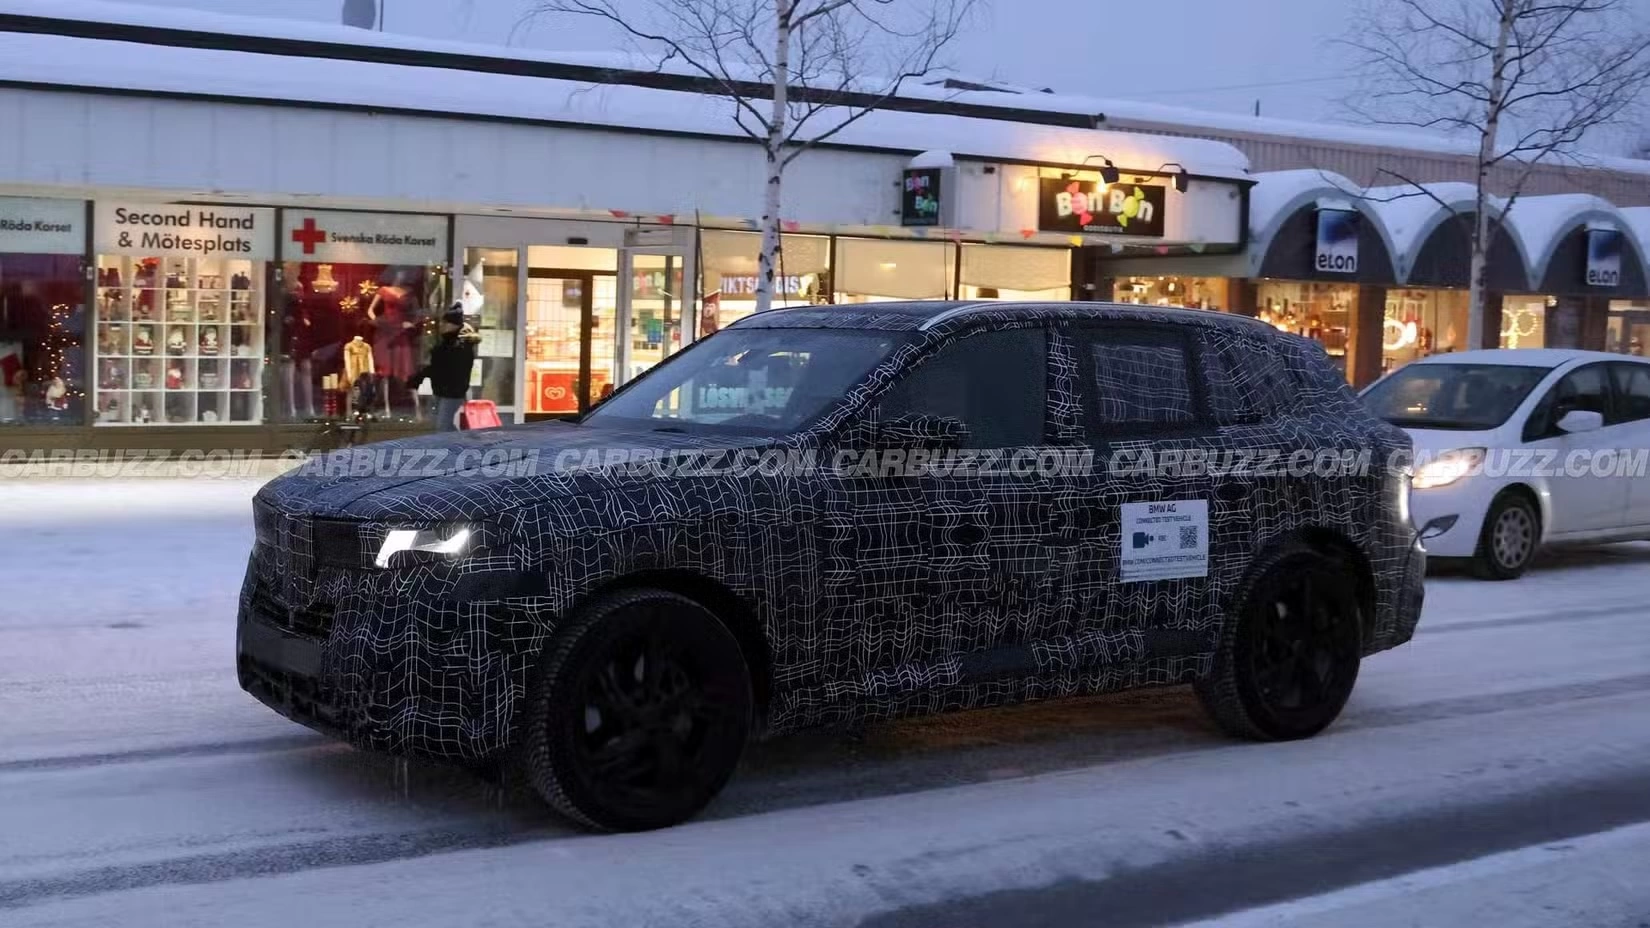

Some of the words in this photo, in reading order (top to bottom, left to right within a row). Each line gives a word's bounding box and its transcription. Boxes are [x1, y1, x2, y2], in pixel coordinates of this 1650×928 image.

[1056, 187, 1103, 219] Bon
[1109, 188, 1153, 223] Bon
[115, 207, 190, 227] Second
[199, 211, 254, 229] Hand
[118, 231, 132, 248] &
[141, 231, 252, 255] Mötesplats
[331, 232, 373, 245] Svenska
[376, 233, 402, 245] Röda
[404, 234, 435, 247] Korset
[1148, 504, 1166, 514] BMW
[1167, 503, 1176, 513] AG
